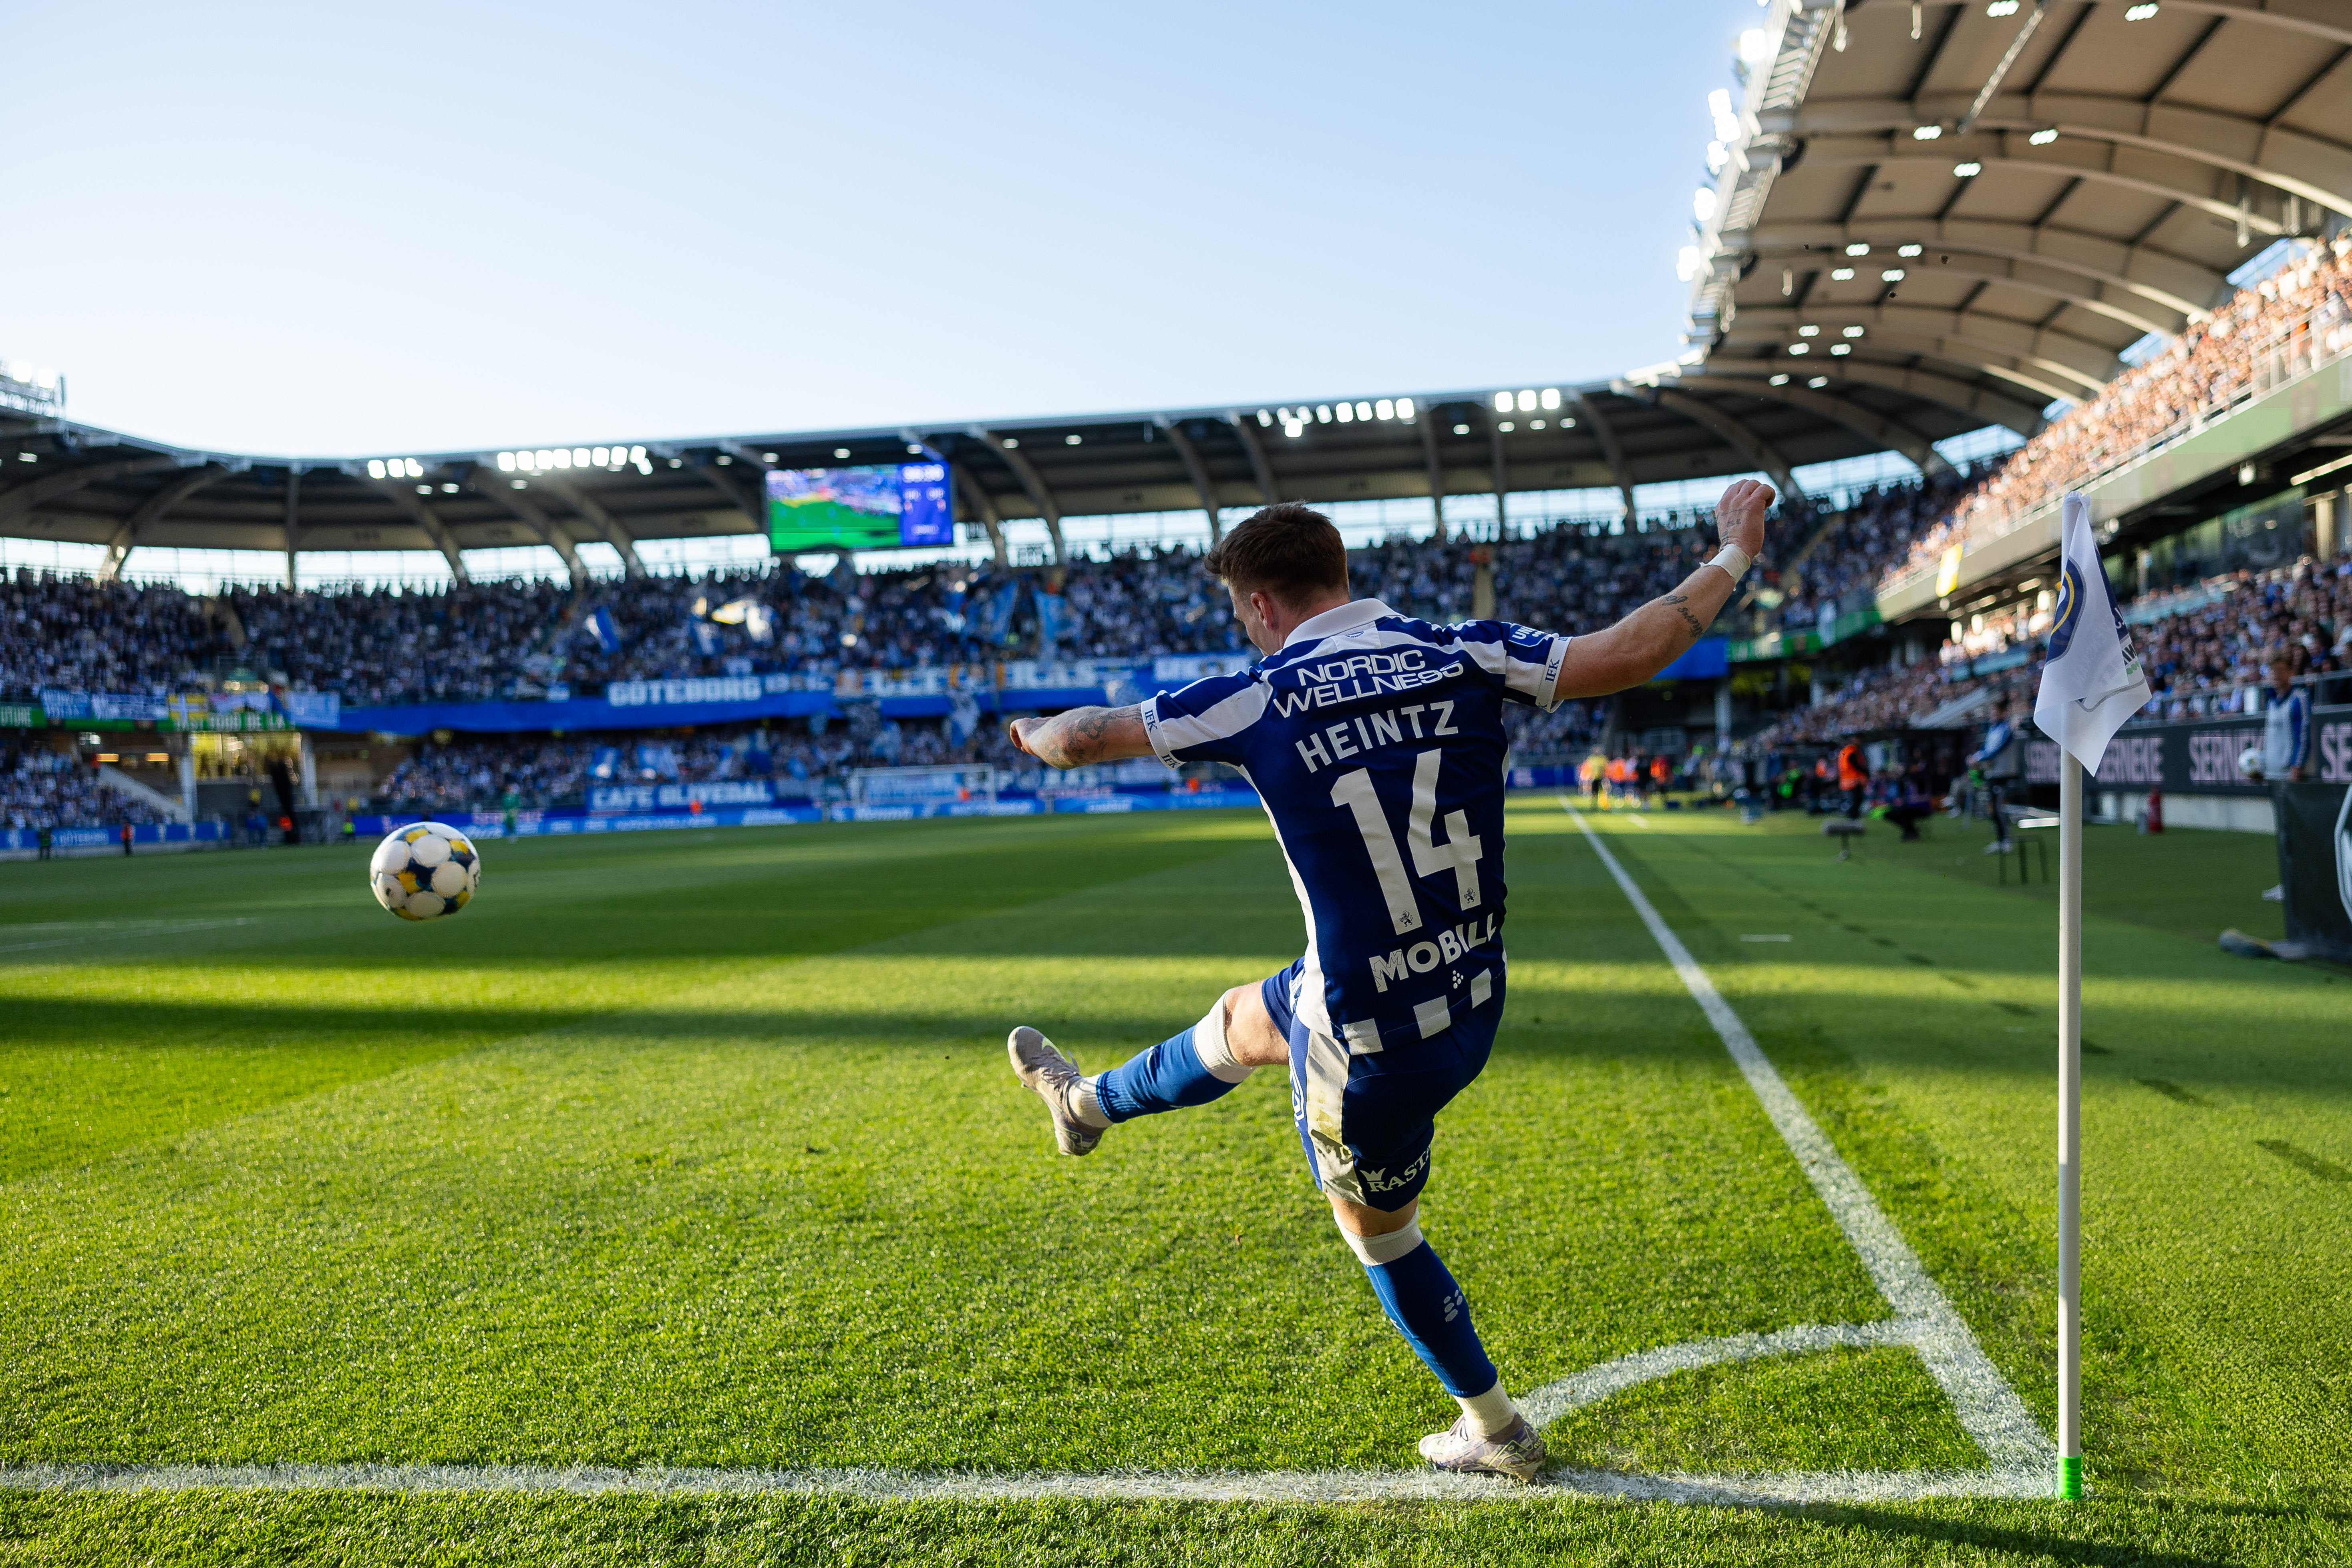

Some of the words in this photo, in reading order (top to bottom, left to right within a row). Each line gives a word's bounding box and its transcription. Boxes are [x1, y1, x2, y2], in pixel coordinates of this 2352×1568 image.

[1512, 626, 1537, 640] UNI
[1297, 650, 1425, 686] NORDIC
[1545, 658, 1560, 682] IFK
[608, 676, 761, 707] GÖTEBORG
[1273, 660, 1464, 718] WELLNESS
[0, 706, 32, 727] UTURE
[1145, 709, 1157, 733] IFK
[1296, 700, 1459, 773] HEINTZ
[2321, 723, 2352, 783] SE
[1161, 754, 1180, 768] IFK
[2096, 736, 2164, 783] ERNEKE
[1330, 748, 1483, 935] 14
[1369, 913, 1497, 993] MOBILL
